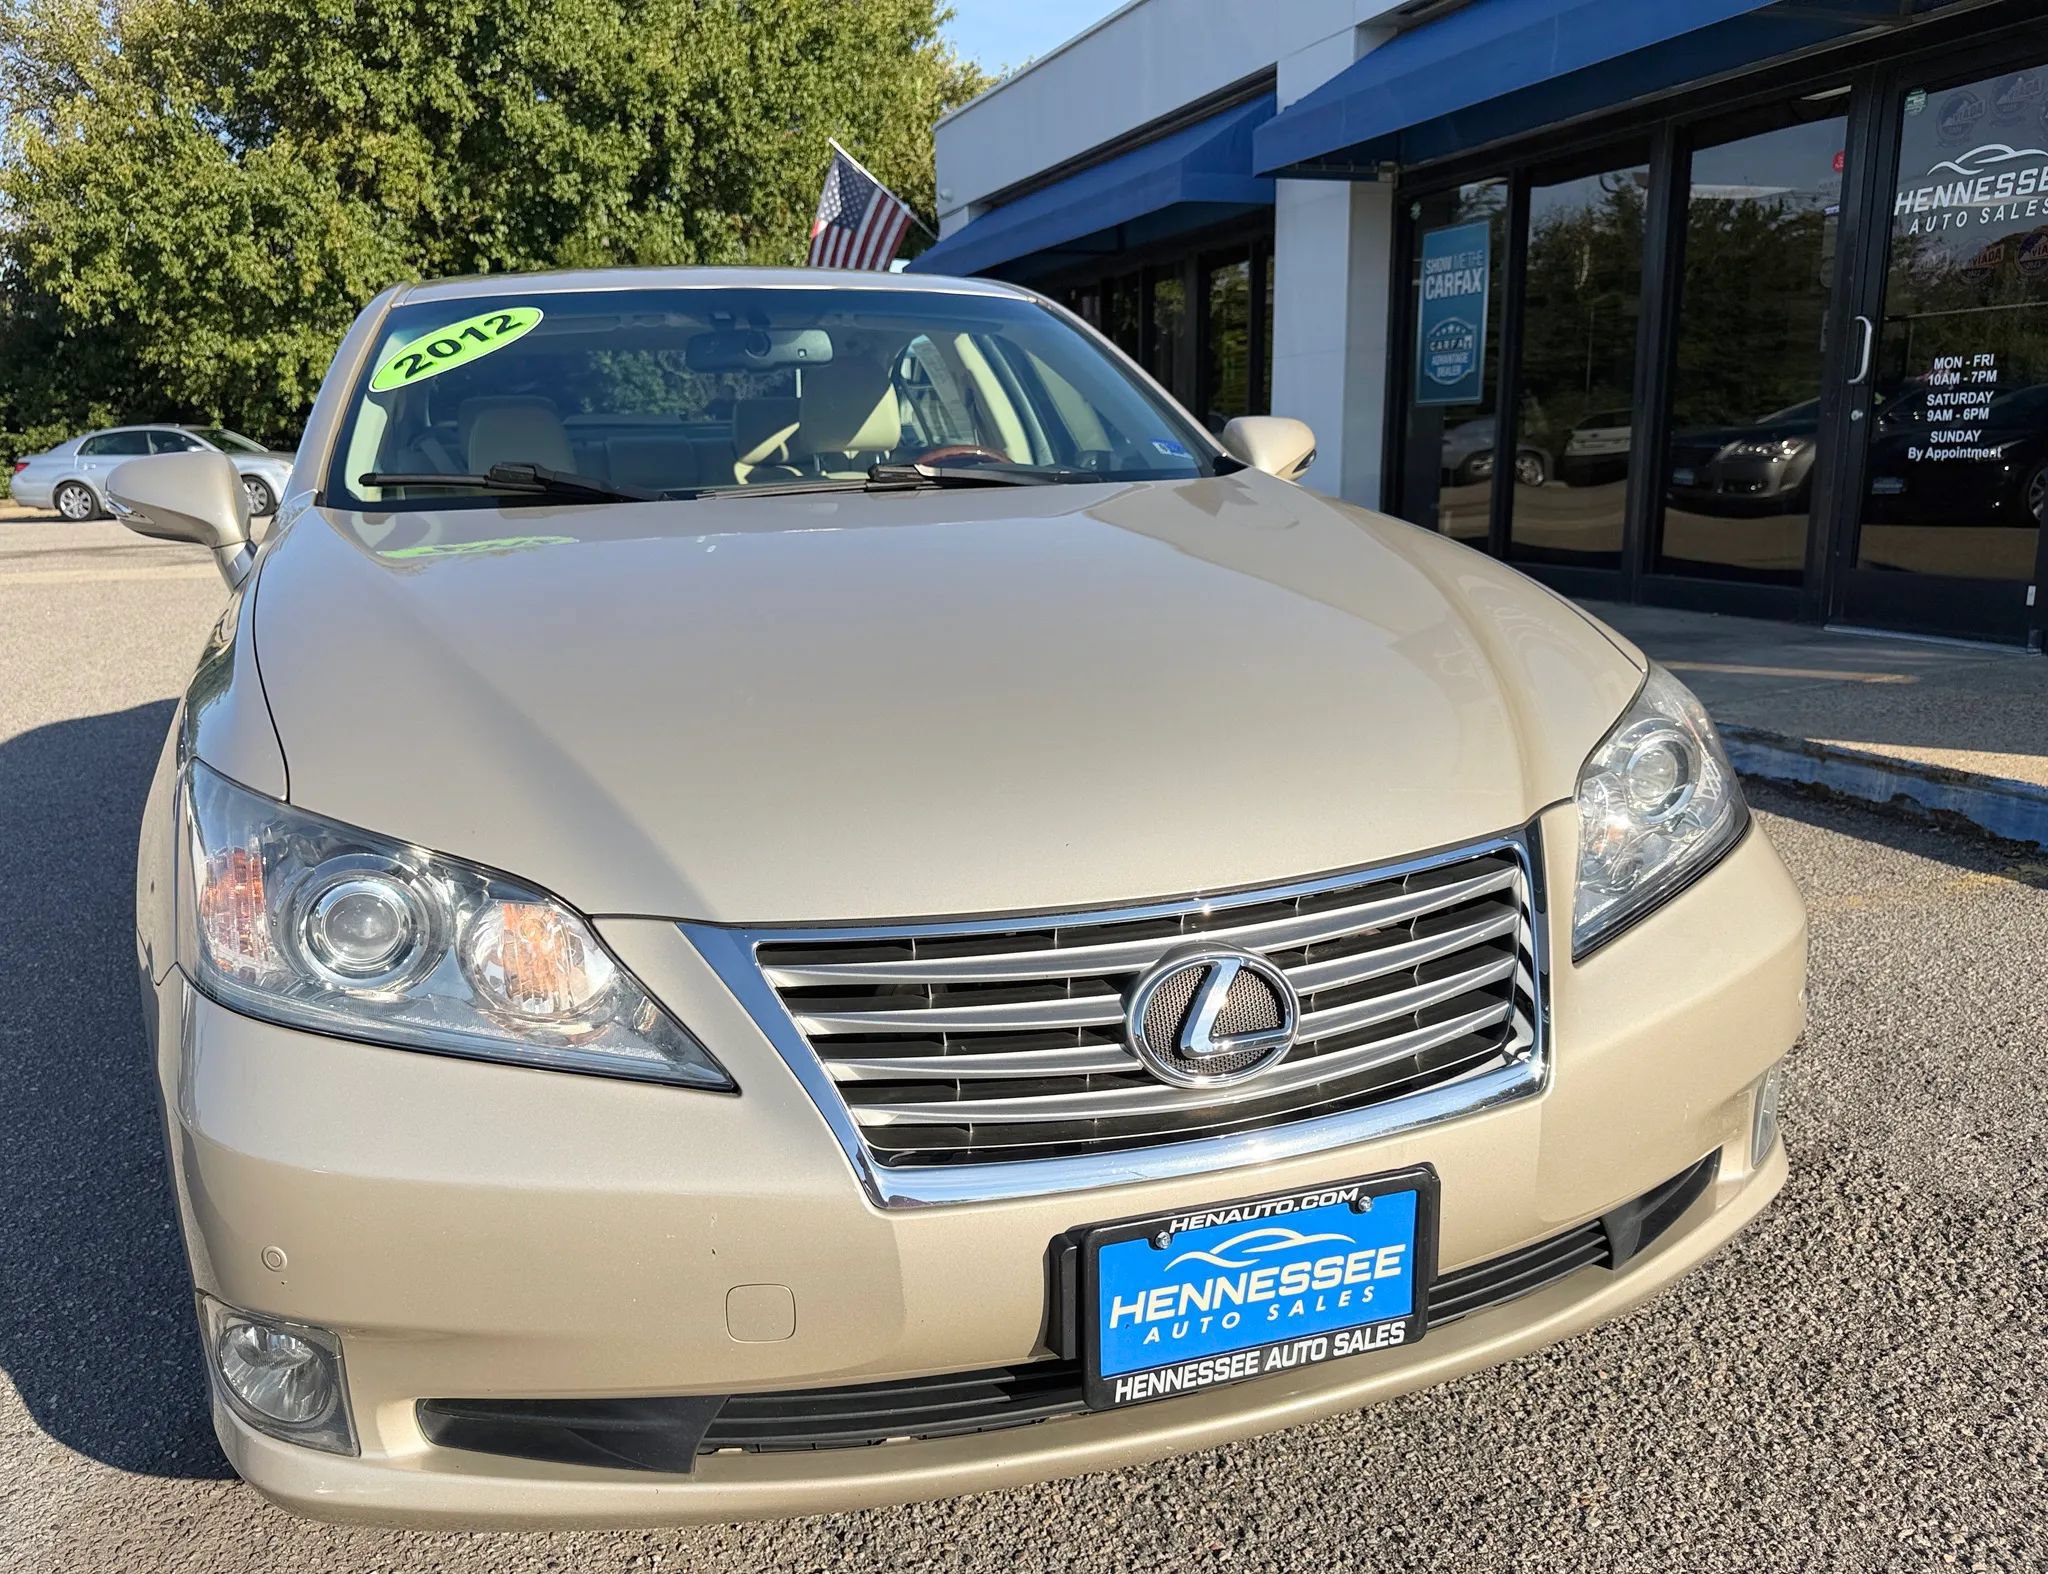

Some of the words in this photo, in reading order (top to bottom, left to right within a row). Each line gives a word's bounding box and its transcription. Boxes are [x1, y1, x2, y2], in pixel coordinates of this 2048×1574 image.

[1909, 211, 1968, 235] AUTO
[1979, 197, 2048, 225] SALES
[1425, 256, 1452, 275] SHOW
[1425, 267, 1483, 300] CARFAX
[393, 314, 523, 379] 2012
[1934, 356, 1963, 370] MON
[1973, 354, 1995, 368] FRI
[1928, 372, 1960, 386] 10AM
[1971, 370, 1998, 384] 7PM
[1926, 391, 1994, 407] SATURDAY
[1926, 410, 1953, 422] 9AM
[1963, 408, 1990, 421] 6PM
[1930, 429, 1982, 443] SUNDAY
[1908, 447, 1923, 461] By
[1925, 446, 2002, 461] Appointment
[1169, 1187, 1359, 1233] HENAUTO.COM
[1109, 1243, 1406, 1329] HENNESSEE
[1142, 1314, 1240, 1345] AUTO
[1267, 1286, 1375, 1321] SALES
[1114, 1350, 1260, 1403] HENNESSEE
[1264, 1337, 1328, 1372] AUTO
[1332, 1321, 1406, 1357] SALES
